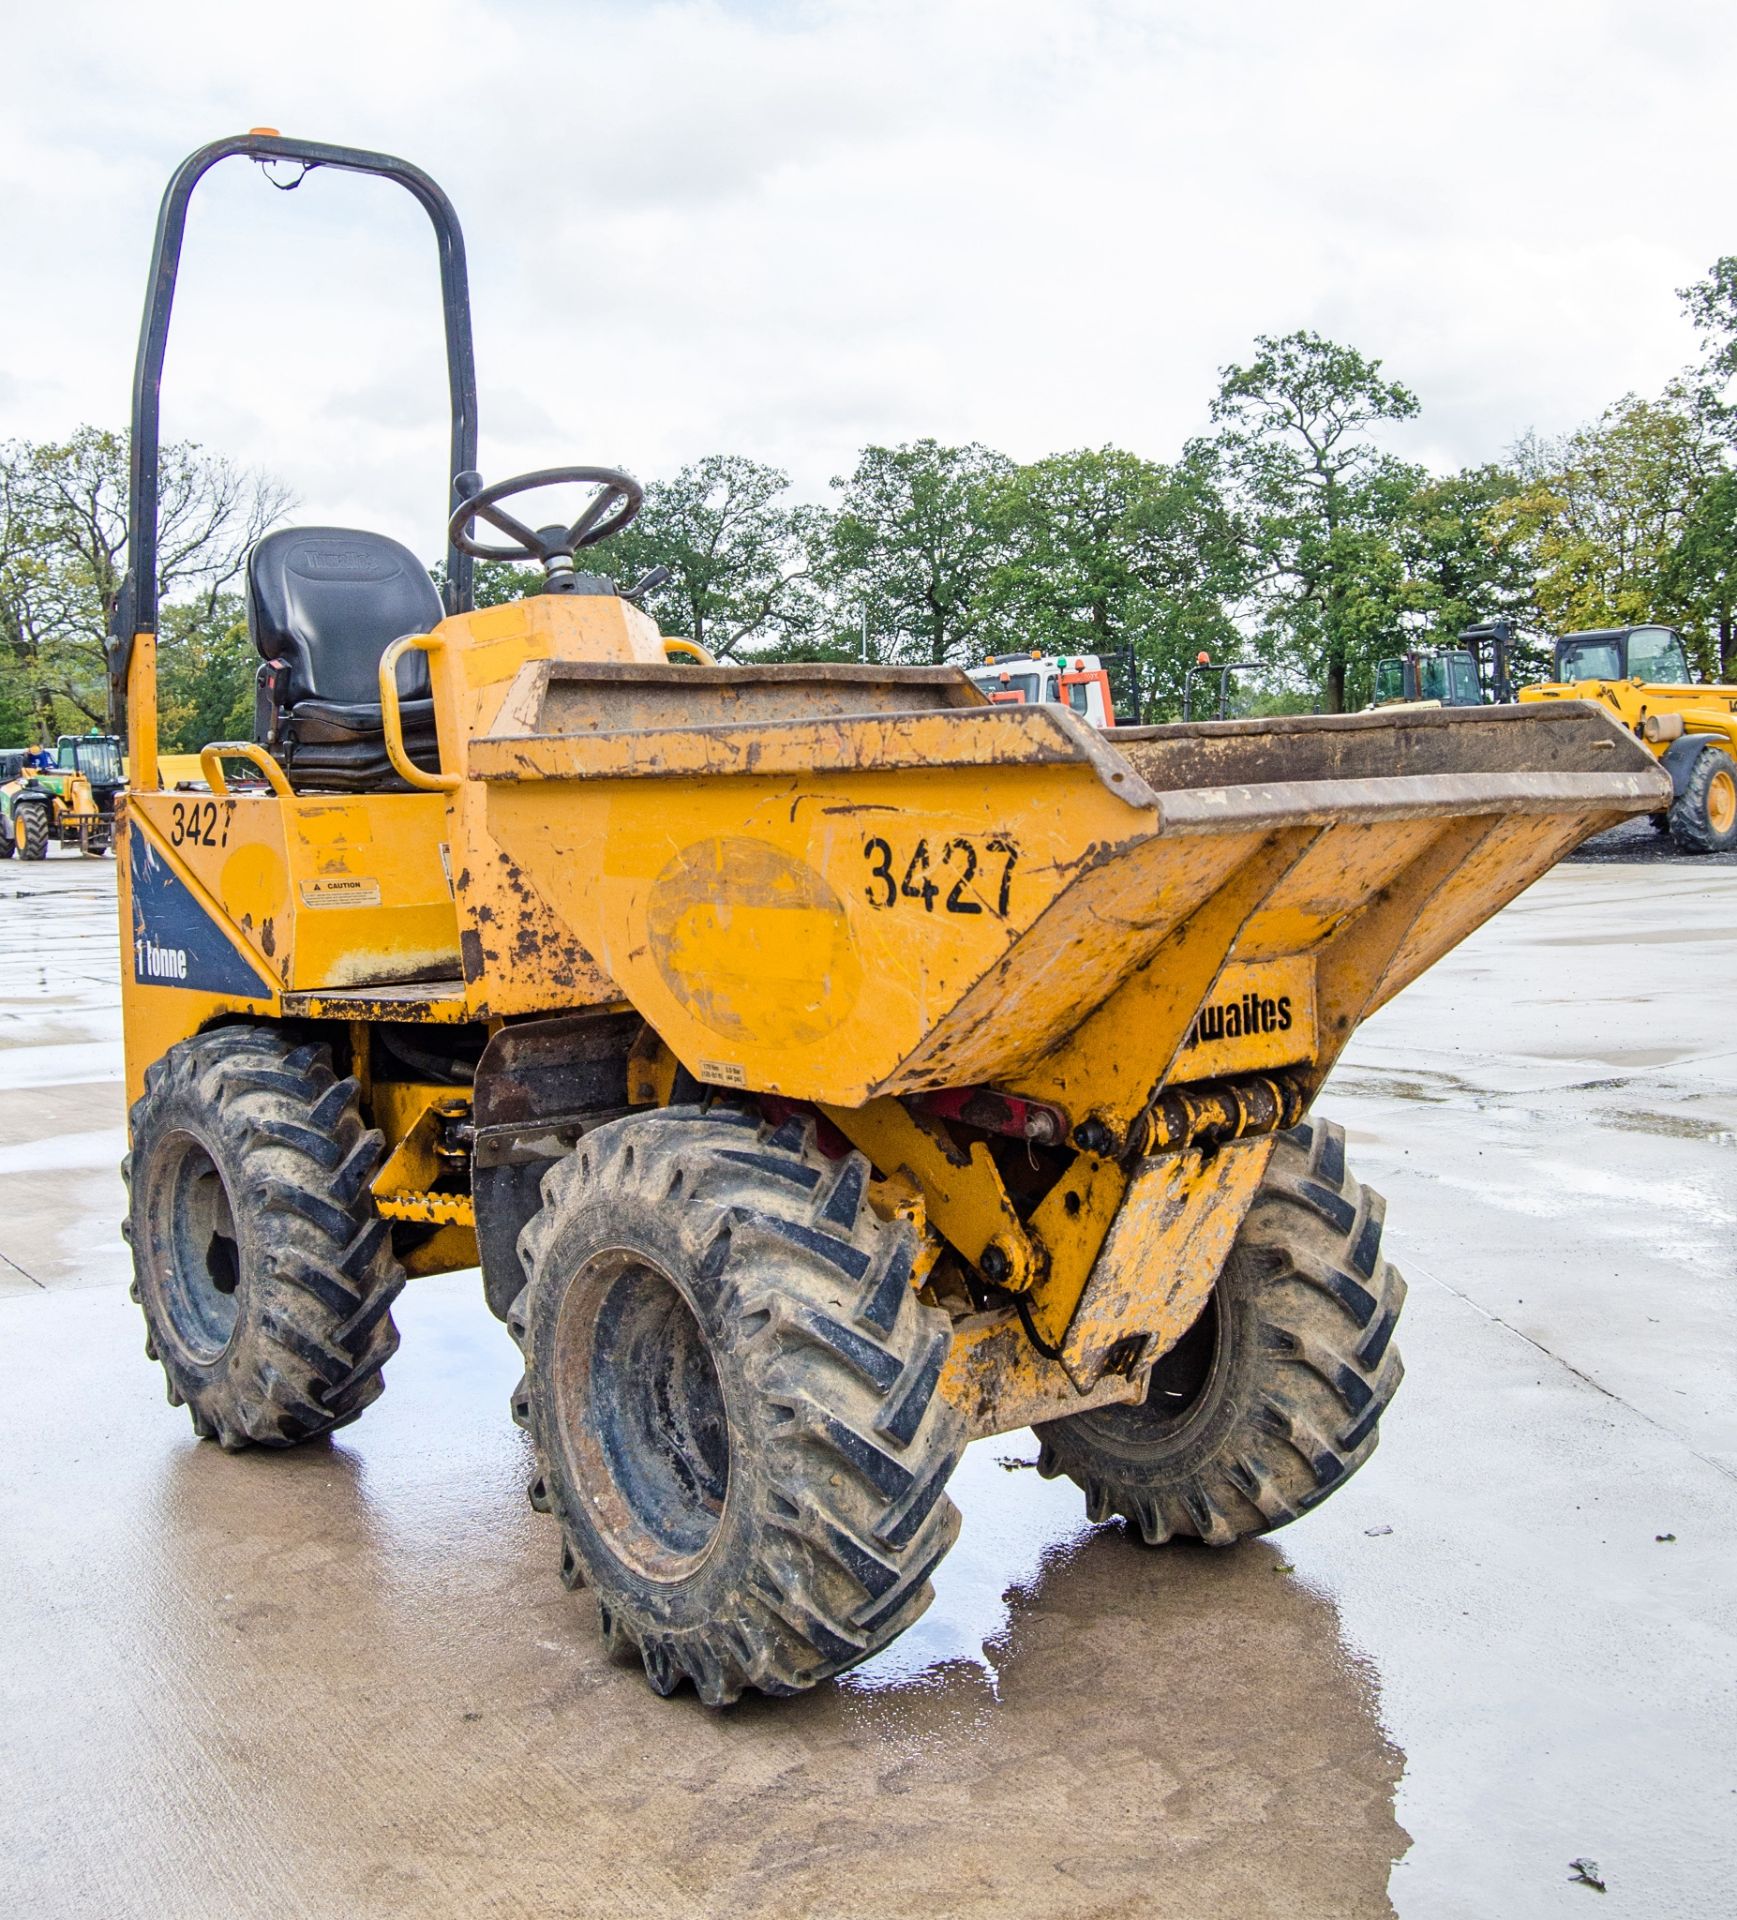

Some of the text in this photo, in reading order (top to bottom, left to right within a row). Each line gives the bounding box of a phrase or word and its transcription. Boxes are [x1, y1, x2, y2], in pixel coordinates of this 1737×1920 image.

[171, 801, 234, 848] 3427
[327, 882, 361, 890] CAUTION
[864, 838, 1019, 917] 3427
[146, 940, 187, 980] tonne
[1184, 993, 1292, 1049] waites
